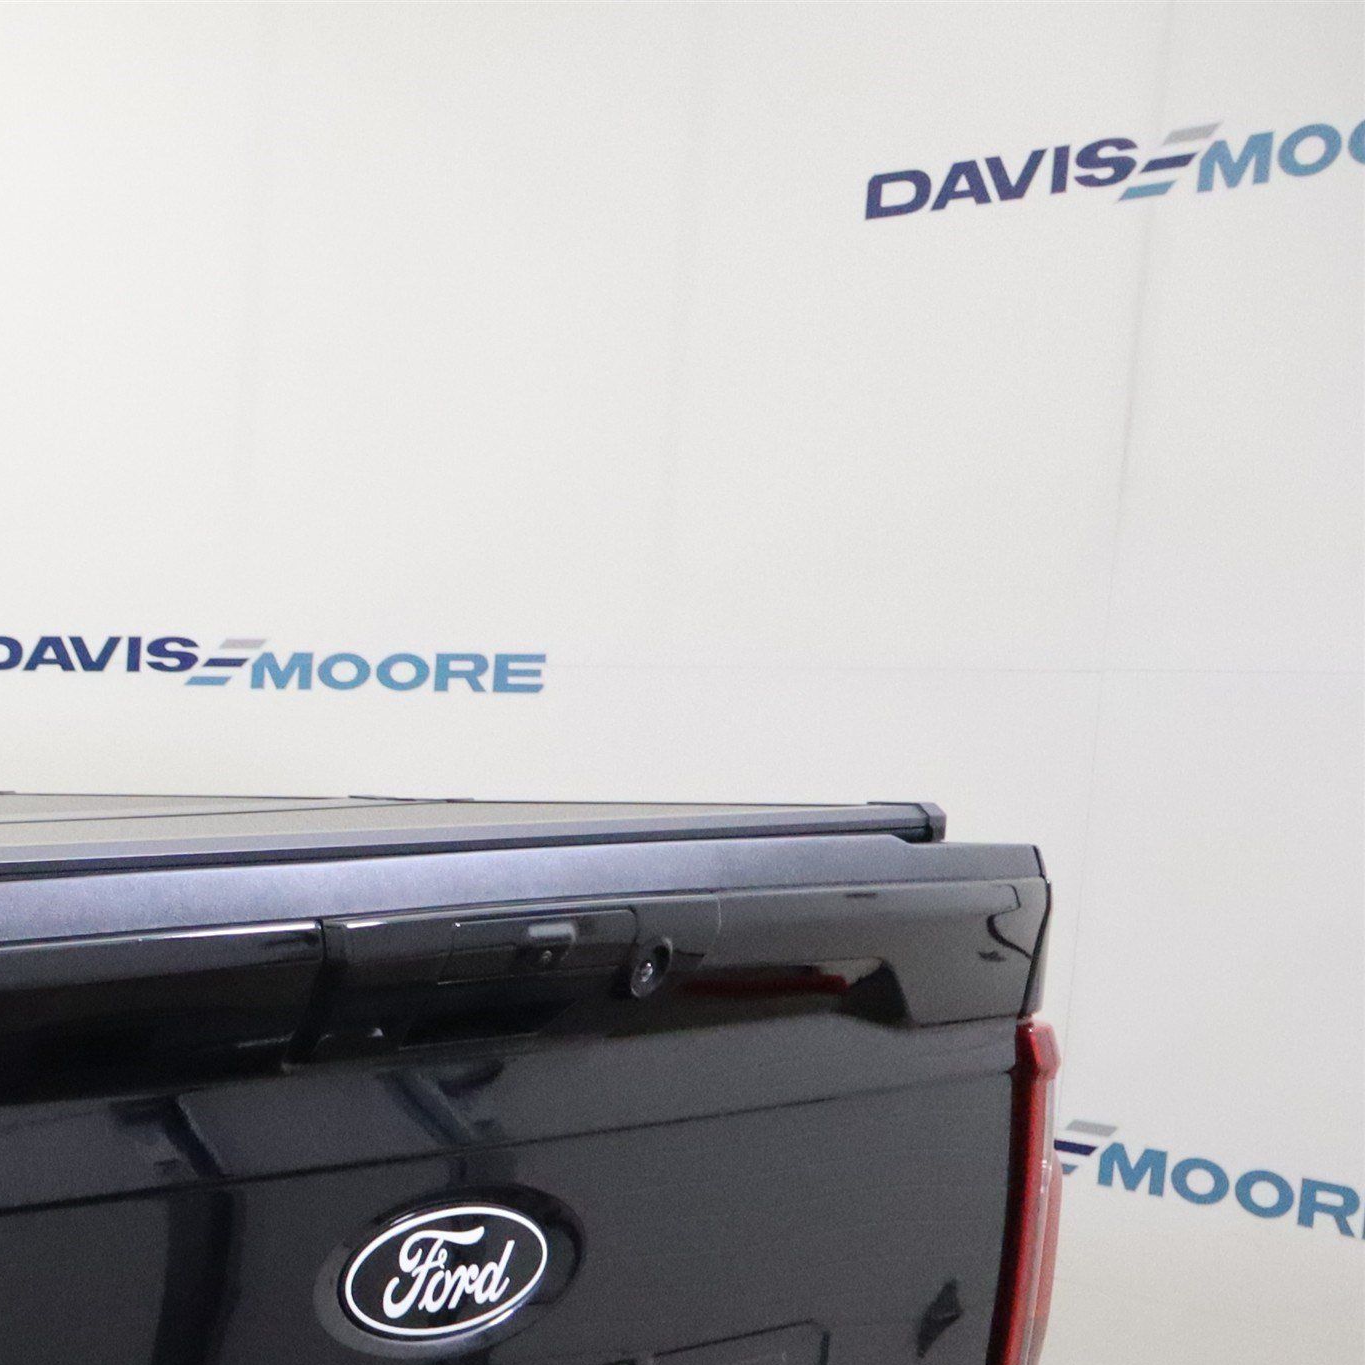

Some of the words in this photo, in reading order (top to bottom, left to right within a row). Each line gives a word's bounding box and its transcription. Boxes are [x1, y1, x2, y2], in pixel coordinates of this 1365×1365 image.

[864, 137, 1138, 221] DAVIS
[1196, 120, 1365, 193] MO
[250, 651, 547, 694] MOORE
[1097, 1141, 1365, 1239] MOOR
[381, 1227, 515, 1318] Ford
